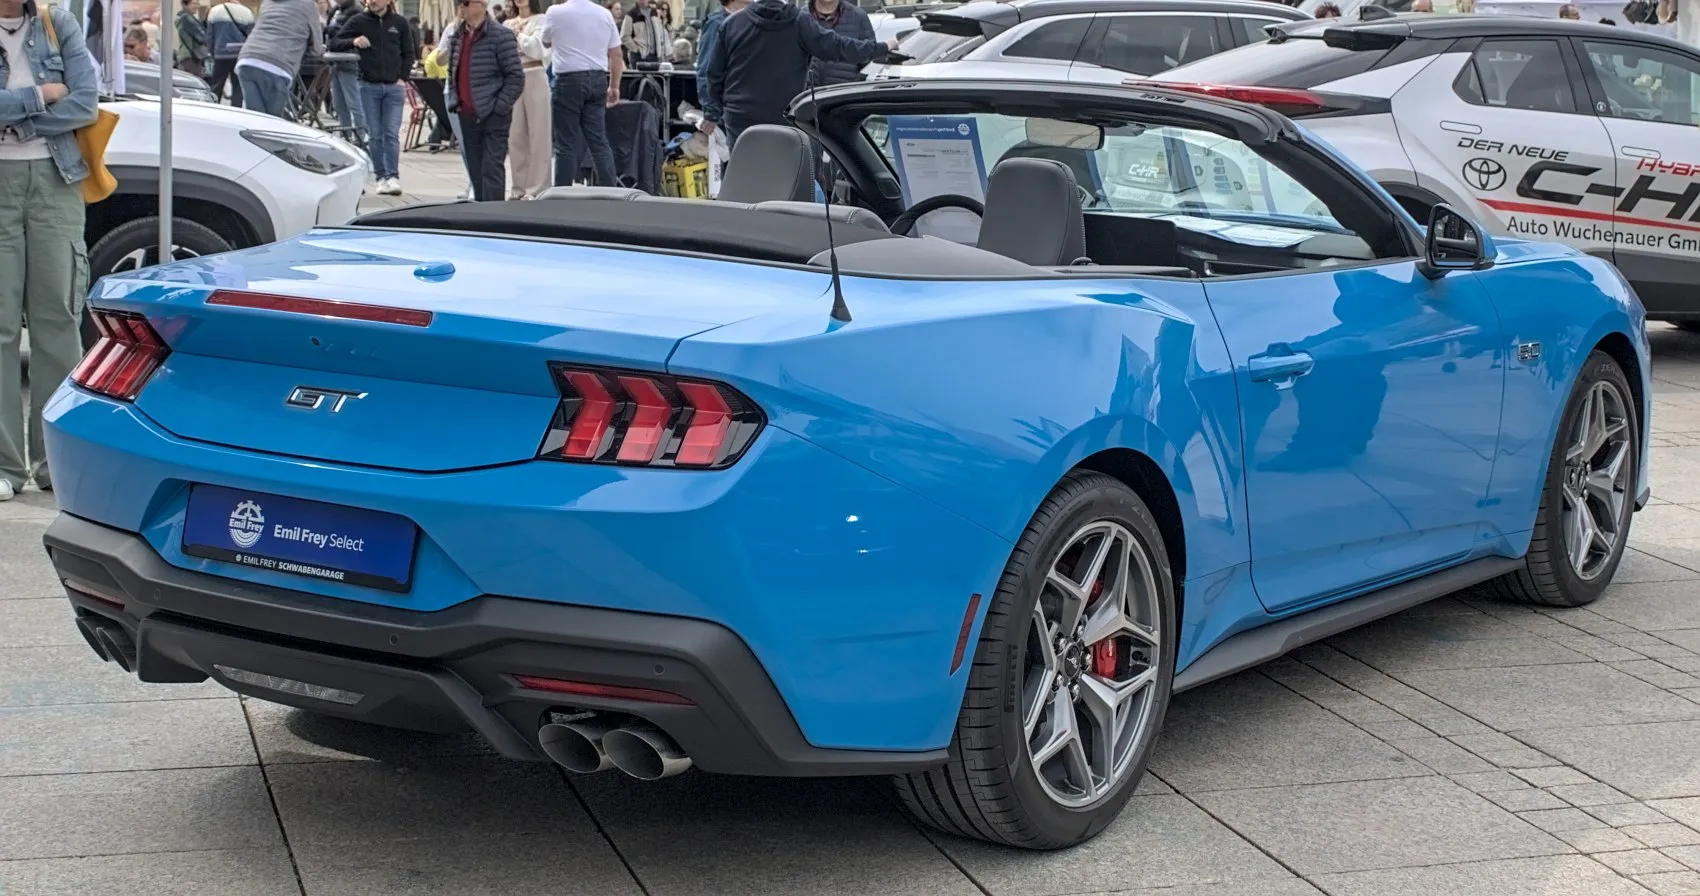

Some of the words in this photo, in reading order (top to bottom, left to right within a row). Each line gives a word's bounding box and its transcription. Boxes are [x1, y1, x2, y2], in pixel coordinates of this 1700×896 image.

[1457, 137, 1504, 153] DER
[1508, 143, 1569, 162] NEUE
[1516, 160, 1700, 223] C-H
[1507, 216, 1548, 236] Auto
[1552, 220, 1664, 249] Wuchenauer
[1668, 233, 1700, 251] Gm
[286, 385, 369, 413] GT
[229, 518, 246, 530] Emil
[246, 520, 265, 534] Frey
[273, 524, 300, 541] Emil
[300, 528, 329, 549] Frey
[329, 533, 365, 552] Select
[243, 555, 260, 566] EMIL
[260, 557, 278, 569] FREY
[278, 561, 345, 580] SCHWABENGARAGE
